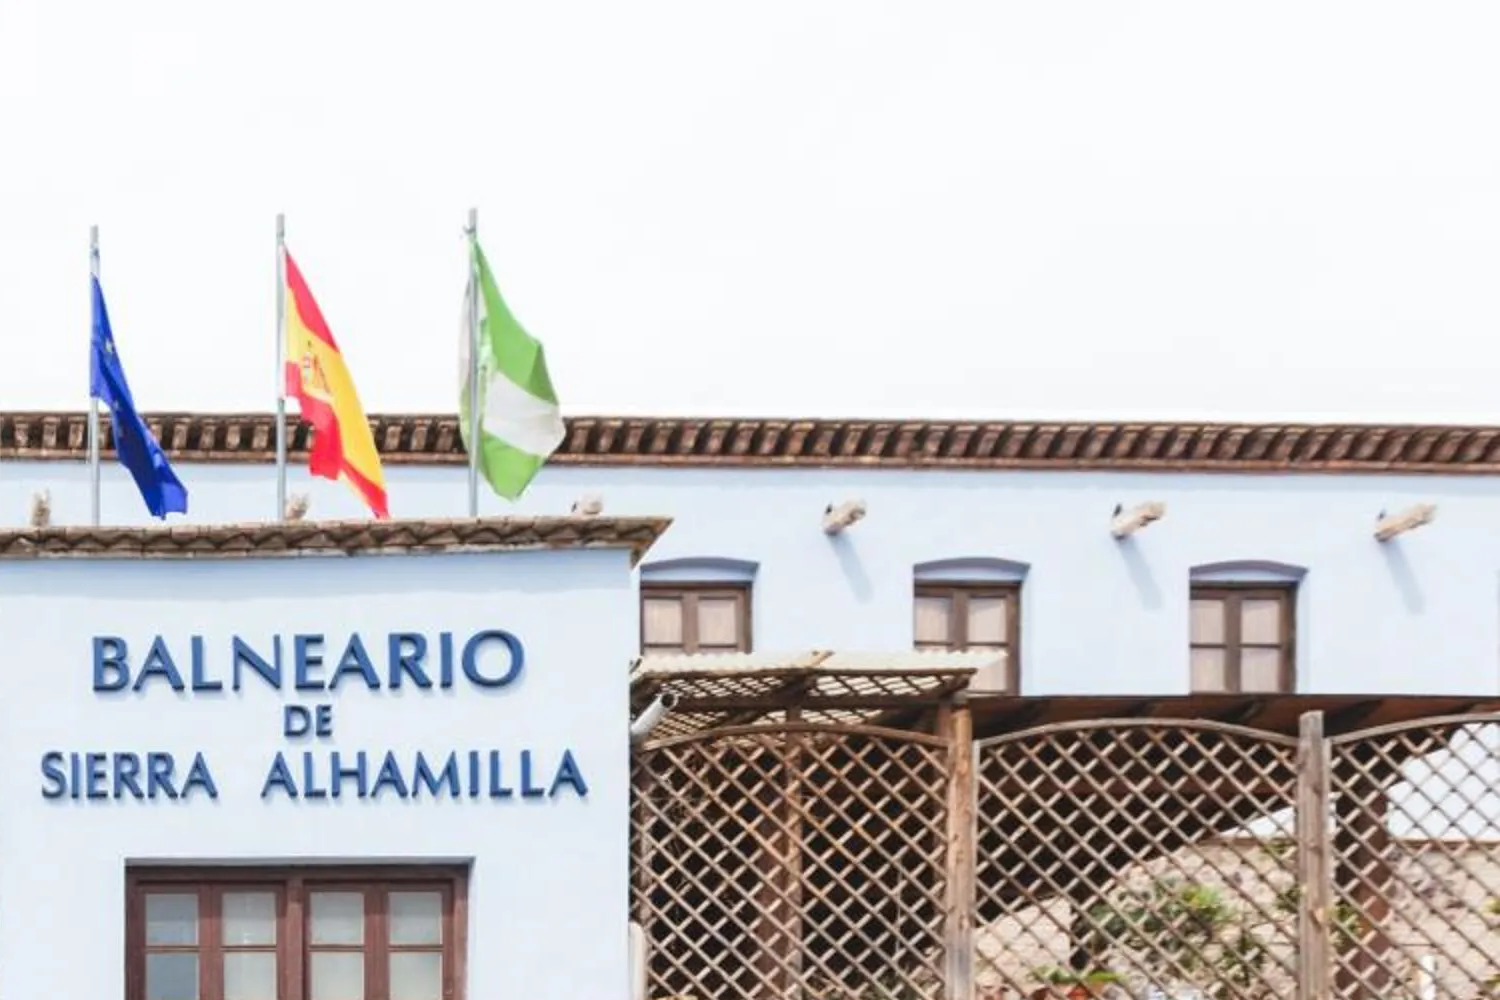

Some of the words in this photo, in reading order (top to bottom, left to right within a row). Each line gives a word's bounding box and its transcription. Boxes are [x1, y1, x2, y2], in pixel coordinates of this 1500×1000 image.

[92, 630, 525, 694] BALNEARIO
[284, 704, 333, 738] DE
[41, 751, 218, 801] SIERRA
[260, 749, 589, 800] ALHAMILLA
